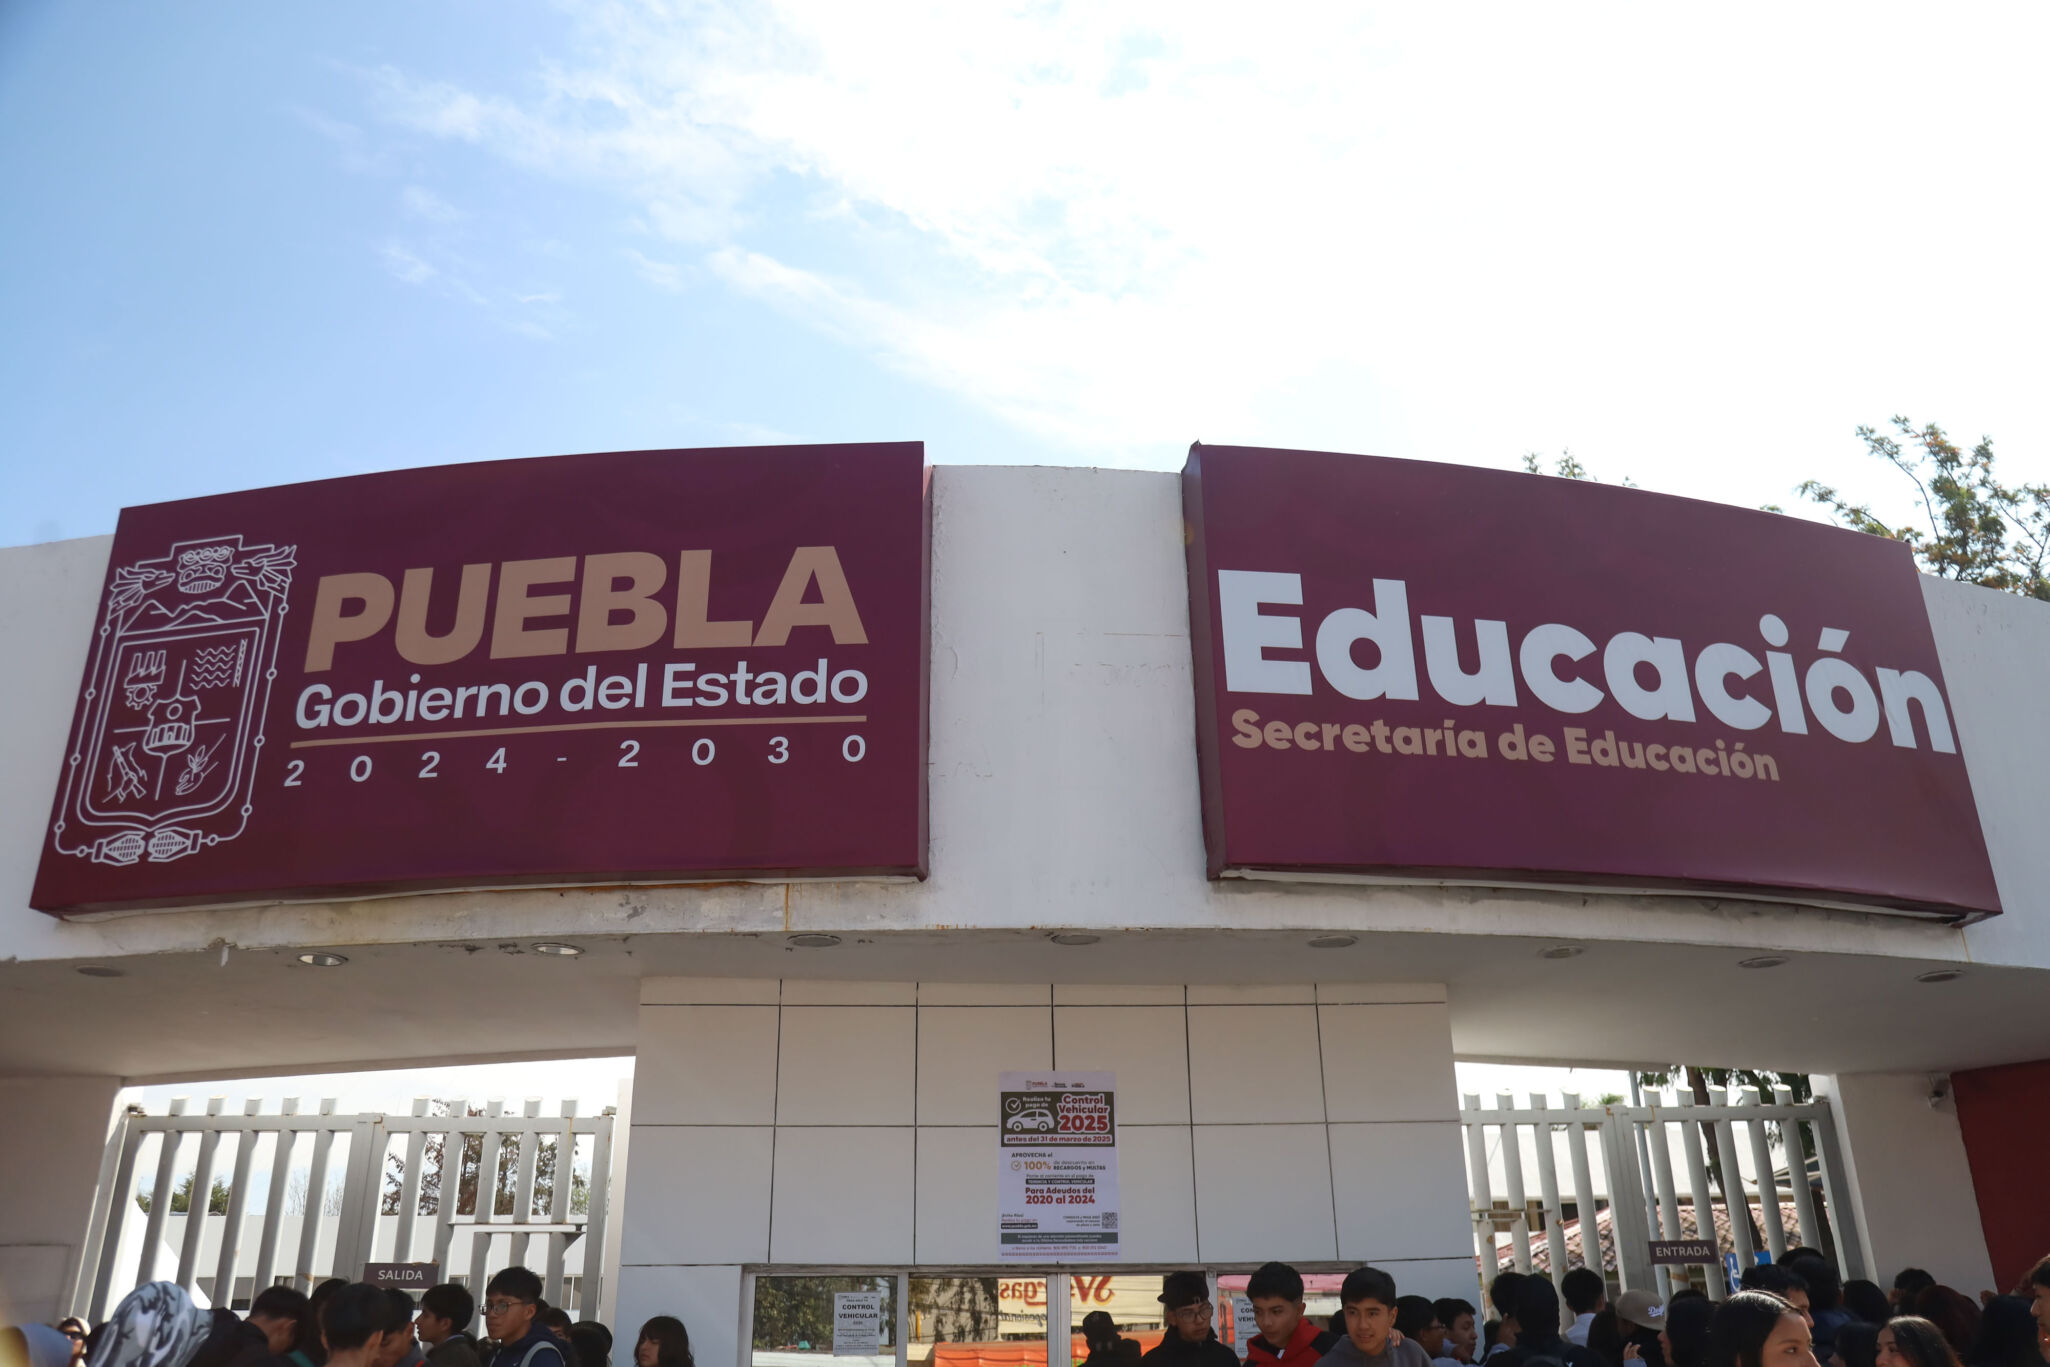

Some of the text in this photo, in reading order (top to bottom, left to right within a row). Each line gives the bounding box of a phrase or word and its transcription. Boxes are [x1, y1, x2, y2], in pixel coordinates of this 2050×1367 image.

[306, 547, 868, 672] PUEBLA
[1218, 570, 1956, 753] Educación
[297, 659, 867, 728] Gobierno del Estado
[1232, 709, 1779, 780] Secretaría de Educación
[1063, 1095, 1103, 1105] Control
[1059, 1105, 1108, 1114] Vehicular
[1059, 1115, 1108, 1131] 2025
[1024, 1161, 1051, 1170] 100%
[1026, 1195, 1095, 1204] 2020 al 2024
[1656, 1246, 1711, 1257] ENTRADA
[377, 1270, 423, 1280] SALIDA
